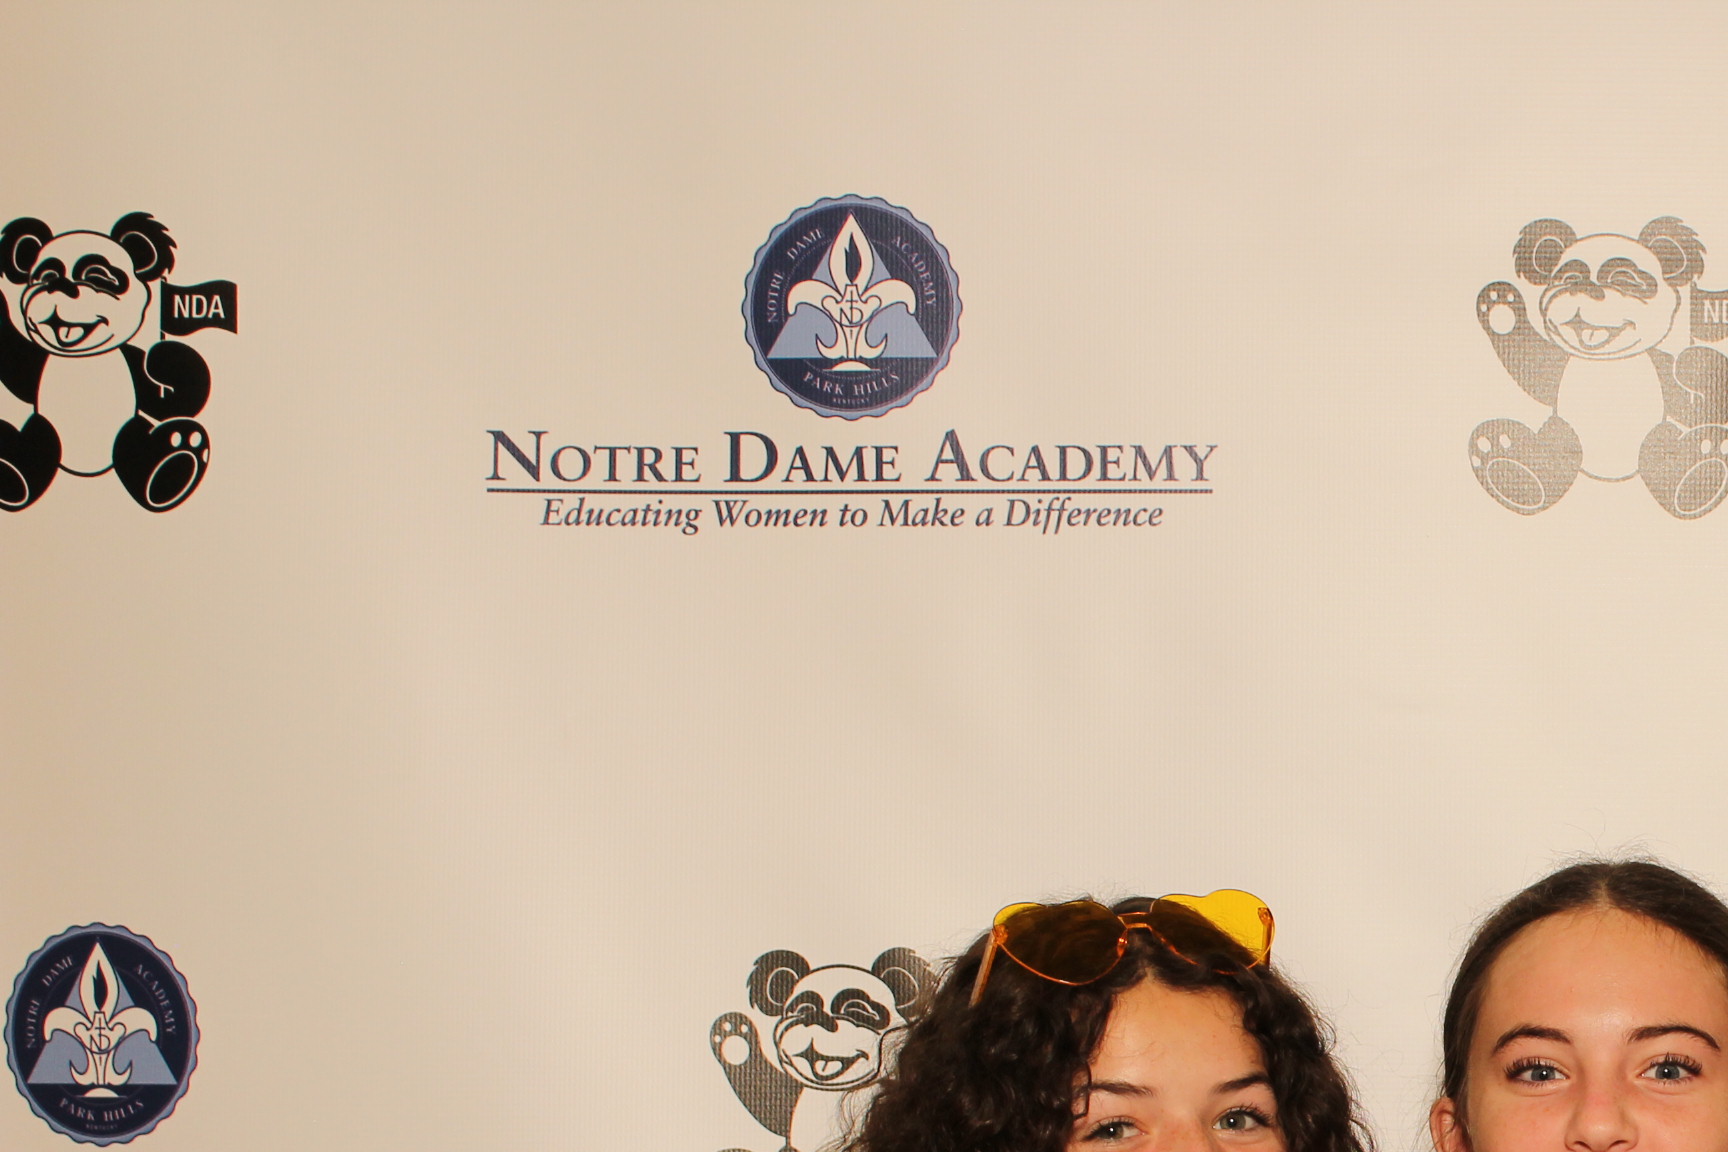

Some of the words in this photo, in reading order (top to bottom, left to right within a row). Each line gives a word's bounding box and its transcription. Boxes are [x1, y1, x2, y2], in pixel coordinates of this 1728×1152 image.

[892, 236, 937, 305] ACADEMY
[173, 294, 225, 319] NDA
[803, 371, 844, 395] PARK
[854, 372, 900, 396] HILLS
[485, 430, 701, 482] NOTRE
[723, 431, 902, 483] DAME
[924, 429, 1218, 482] ACADEMY
[540, 497, 702, 535] Educating
[712, 500, 827, 527] Women
[839, 504, 868, 527] to
[877, 497, 965, 527] Make
[975, 508, 993, 527] a
[1003, 496, 1163, 535] Difference
[59, 1097, 95, 1121] PARK
[103, 1100, 145, 1122] HILLS
